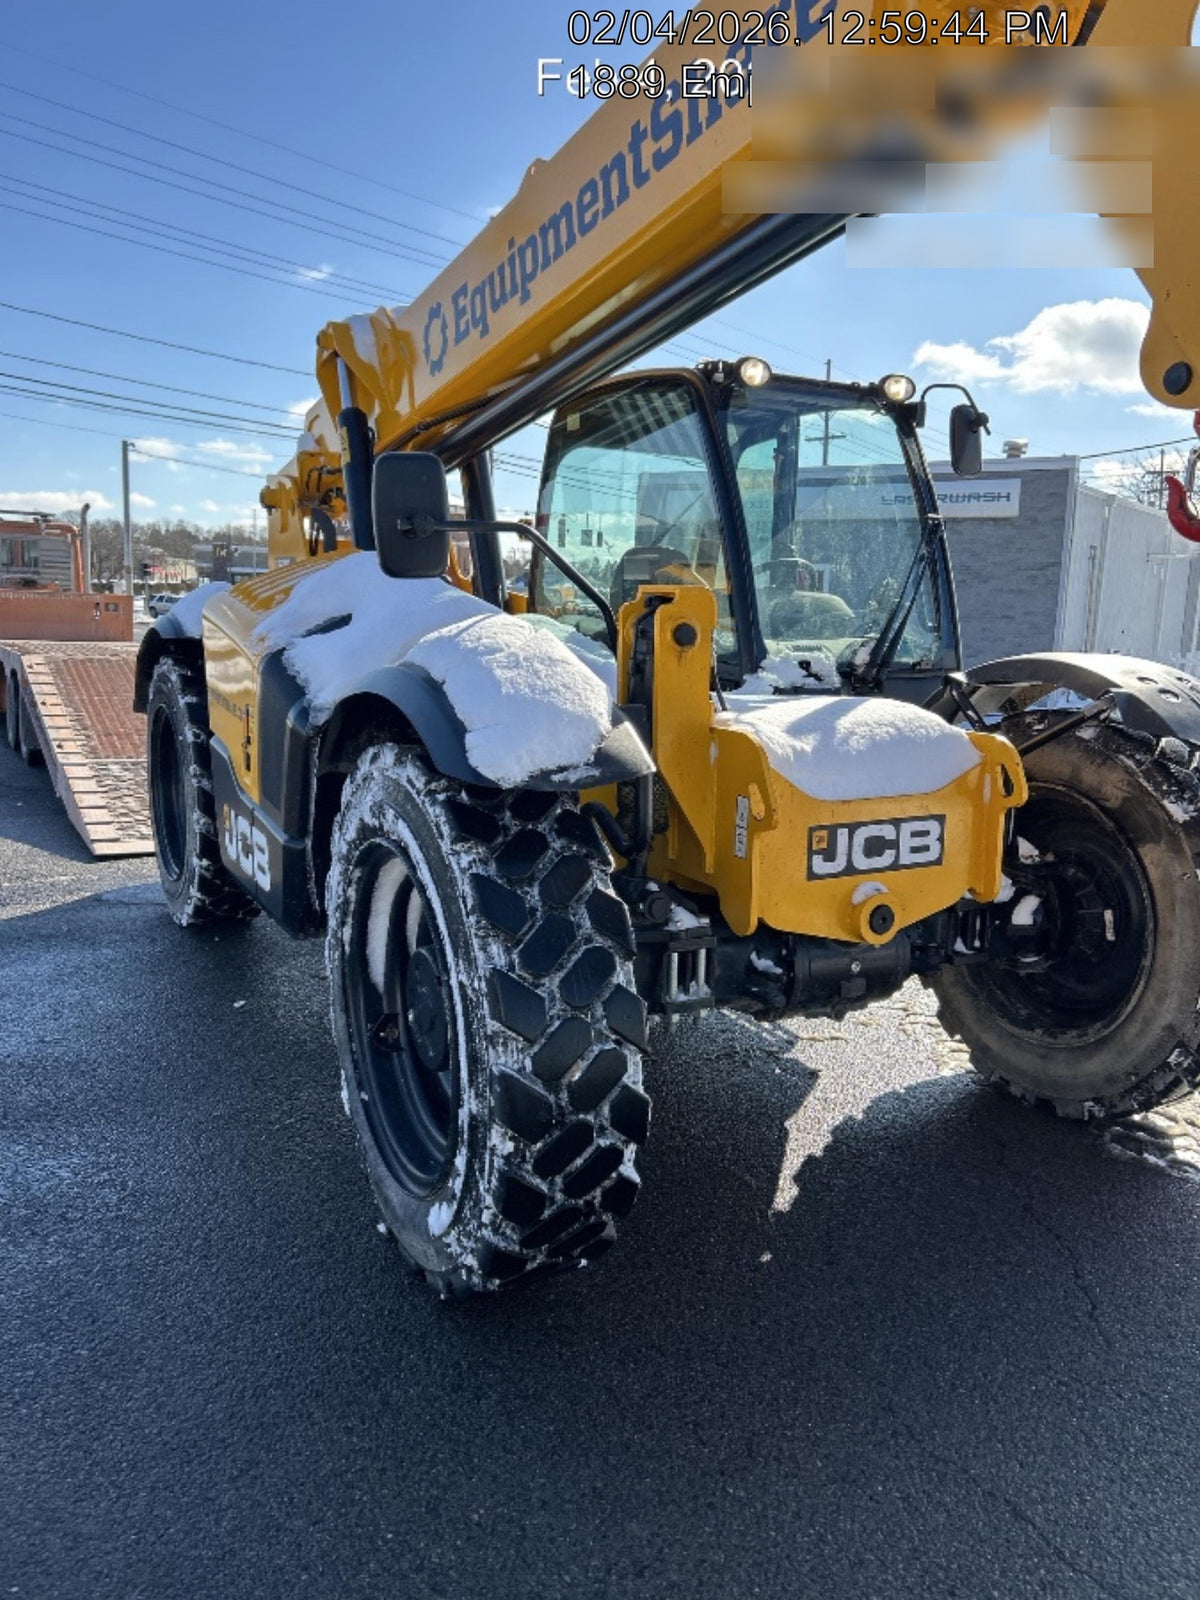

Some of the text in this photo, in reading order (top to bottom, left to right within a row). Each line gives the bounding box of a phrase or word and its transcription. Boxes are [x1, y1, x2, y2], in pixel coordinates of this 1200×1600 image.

[881, 491, 1011, 506] LASRWASH
[224, 808, 271, 892] JCB
[811, 819, 942, 875] JCB
